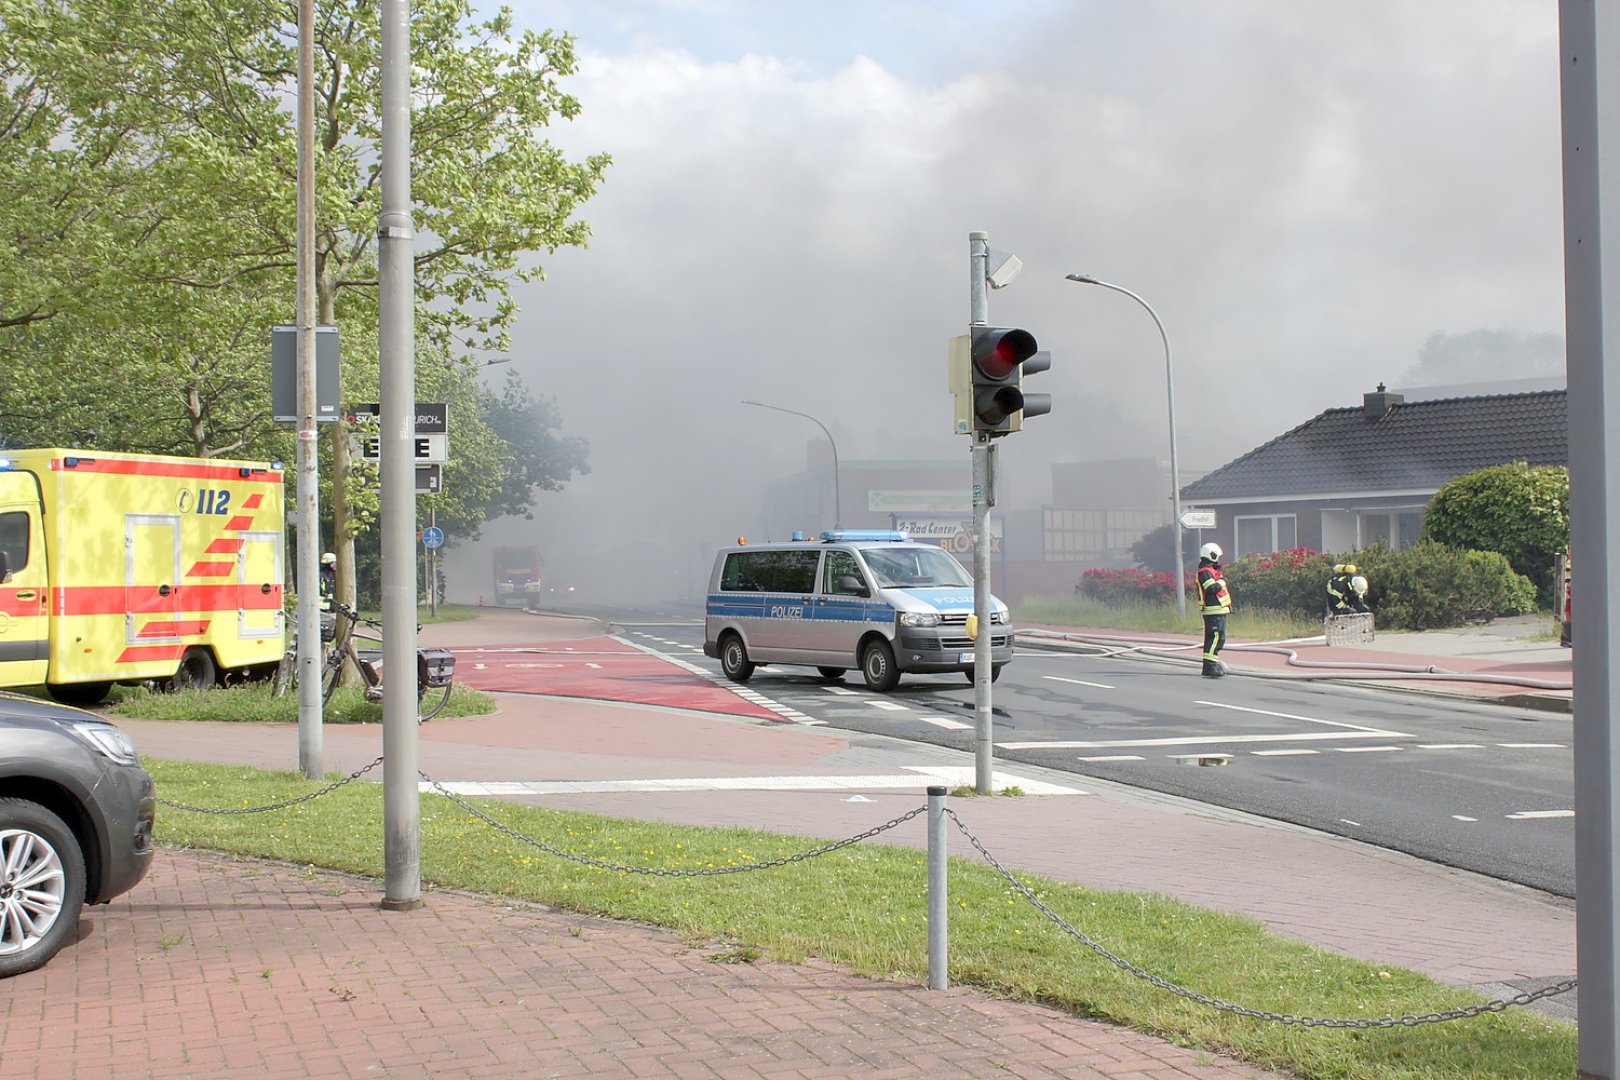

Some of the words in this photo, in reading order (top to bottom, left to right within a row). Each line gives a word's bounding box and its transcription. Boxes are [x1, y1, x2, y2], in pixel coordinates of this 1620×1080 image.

[196, 488, 231, 515] 112
[899, 521, 928, 534] 2-Rad
[929, 521, 957, 534] Center
[940, 532, 1001, 553] BLOK
[771, 605, 804, 618] POLIZEI
